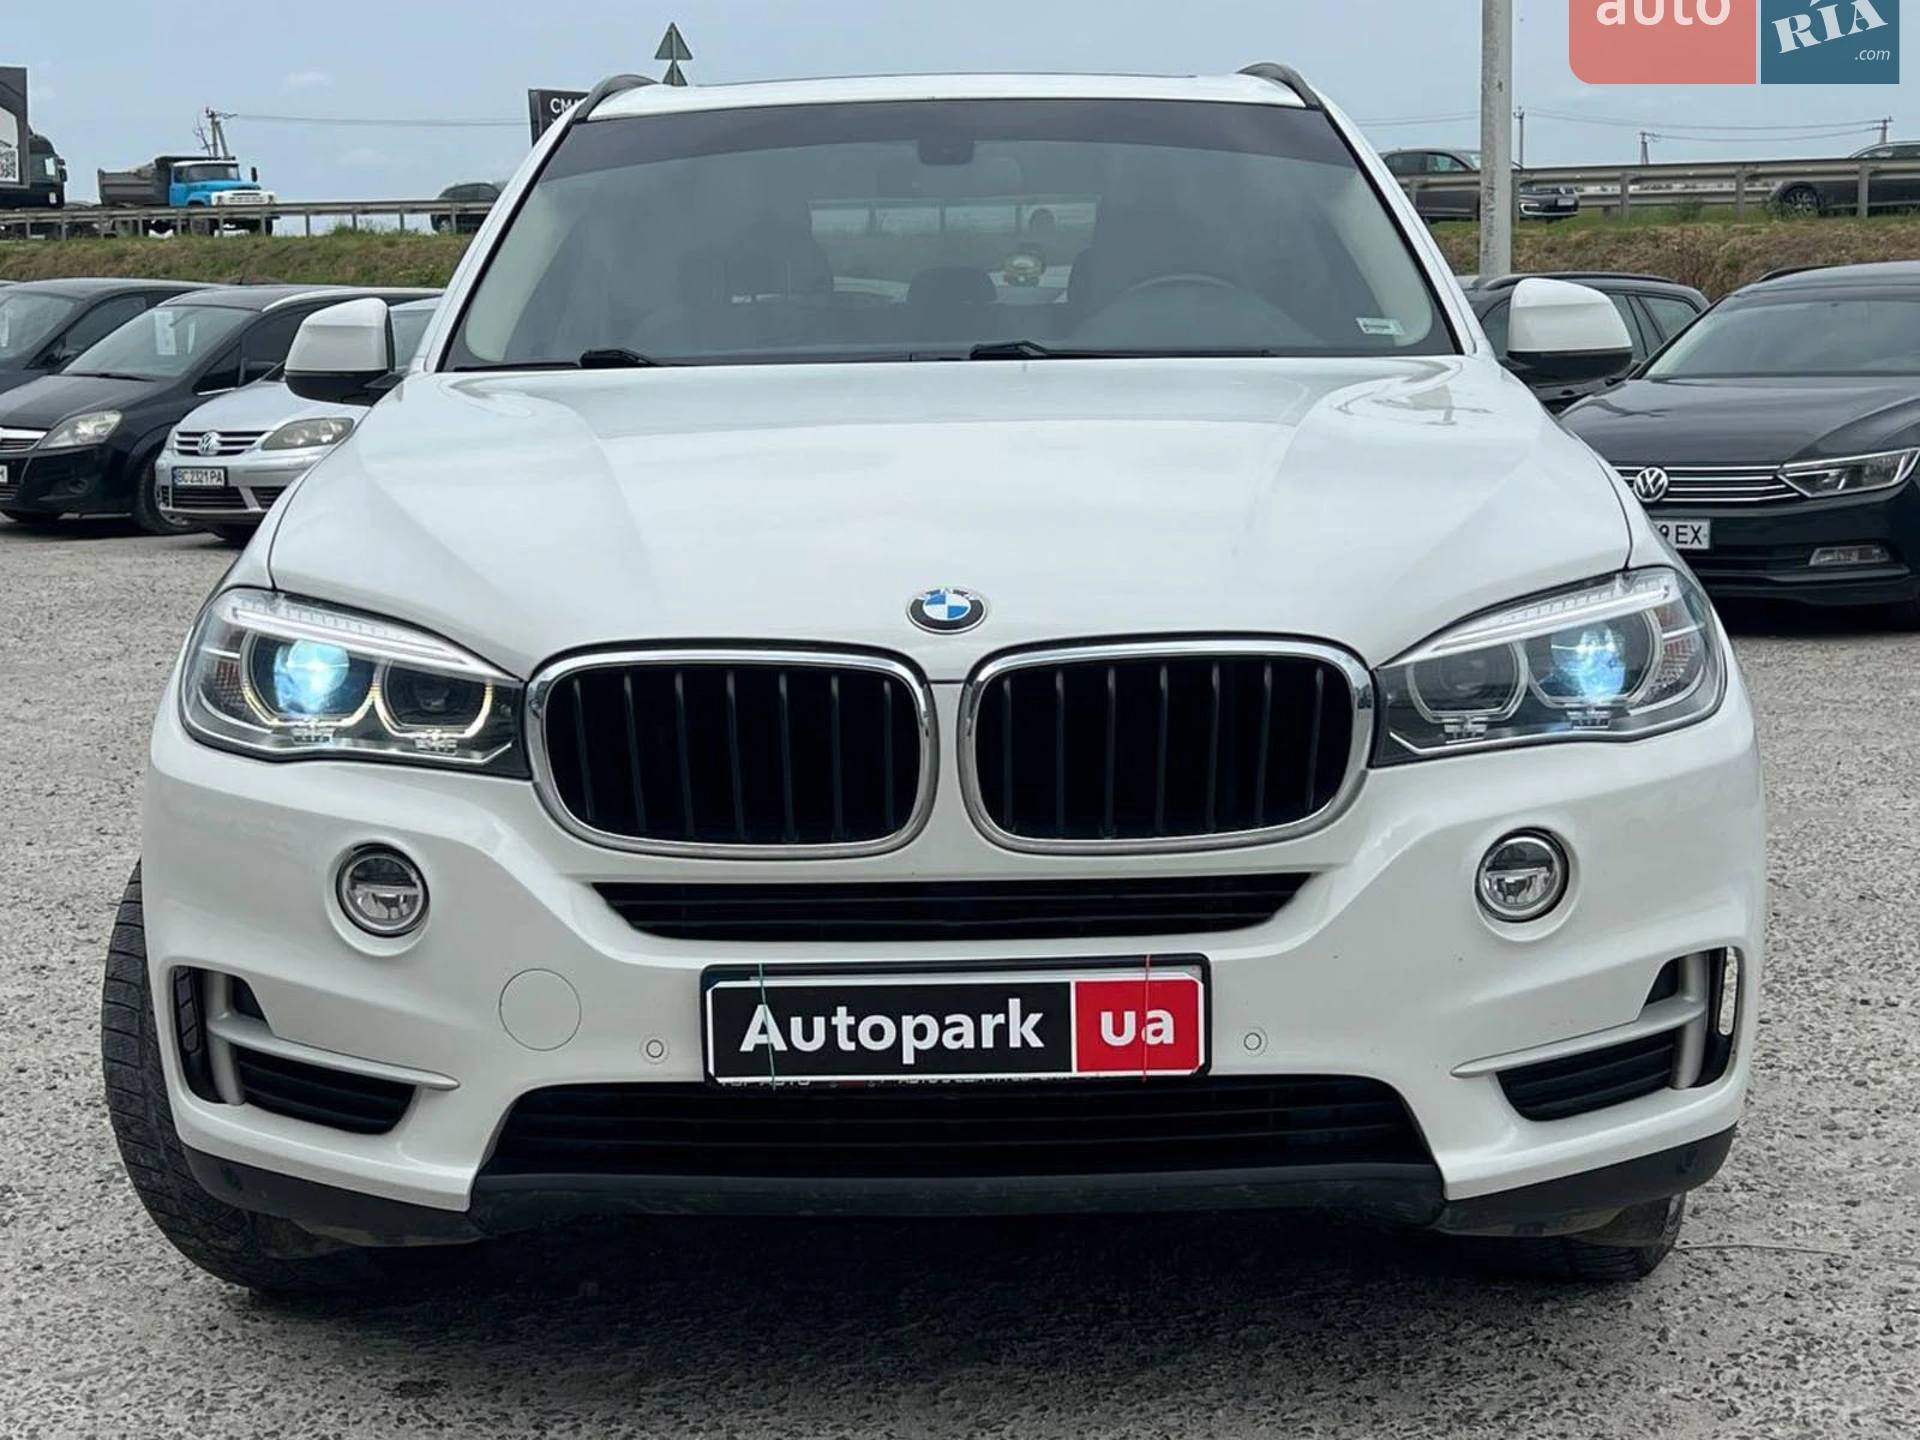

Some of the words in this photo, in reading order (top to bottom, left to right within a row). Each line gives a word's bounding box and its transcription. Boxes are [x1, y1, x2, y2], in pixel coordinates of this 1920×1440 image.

[1674, 524, 1702, 545] EX
[739, 998, 1045, 1065] Autopark
[1100, 1007, 1175, 1047] ua
